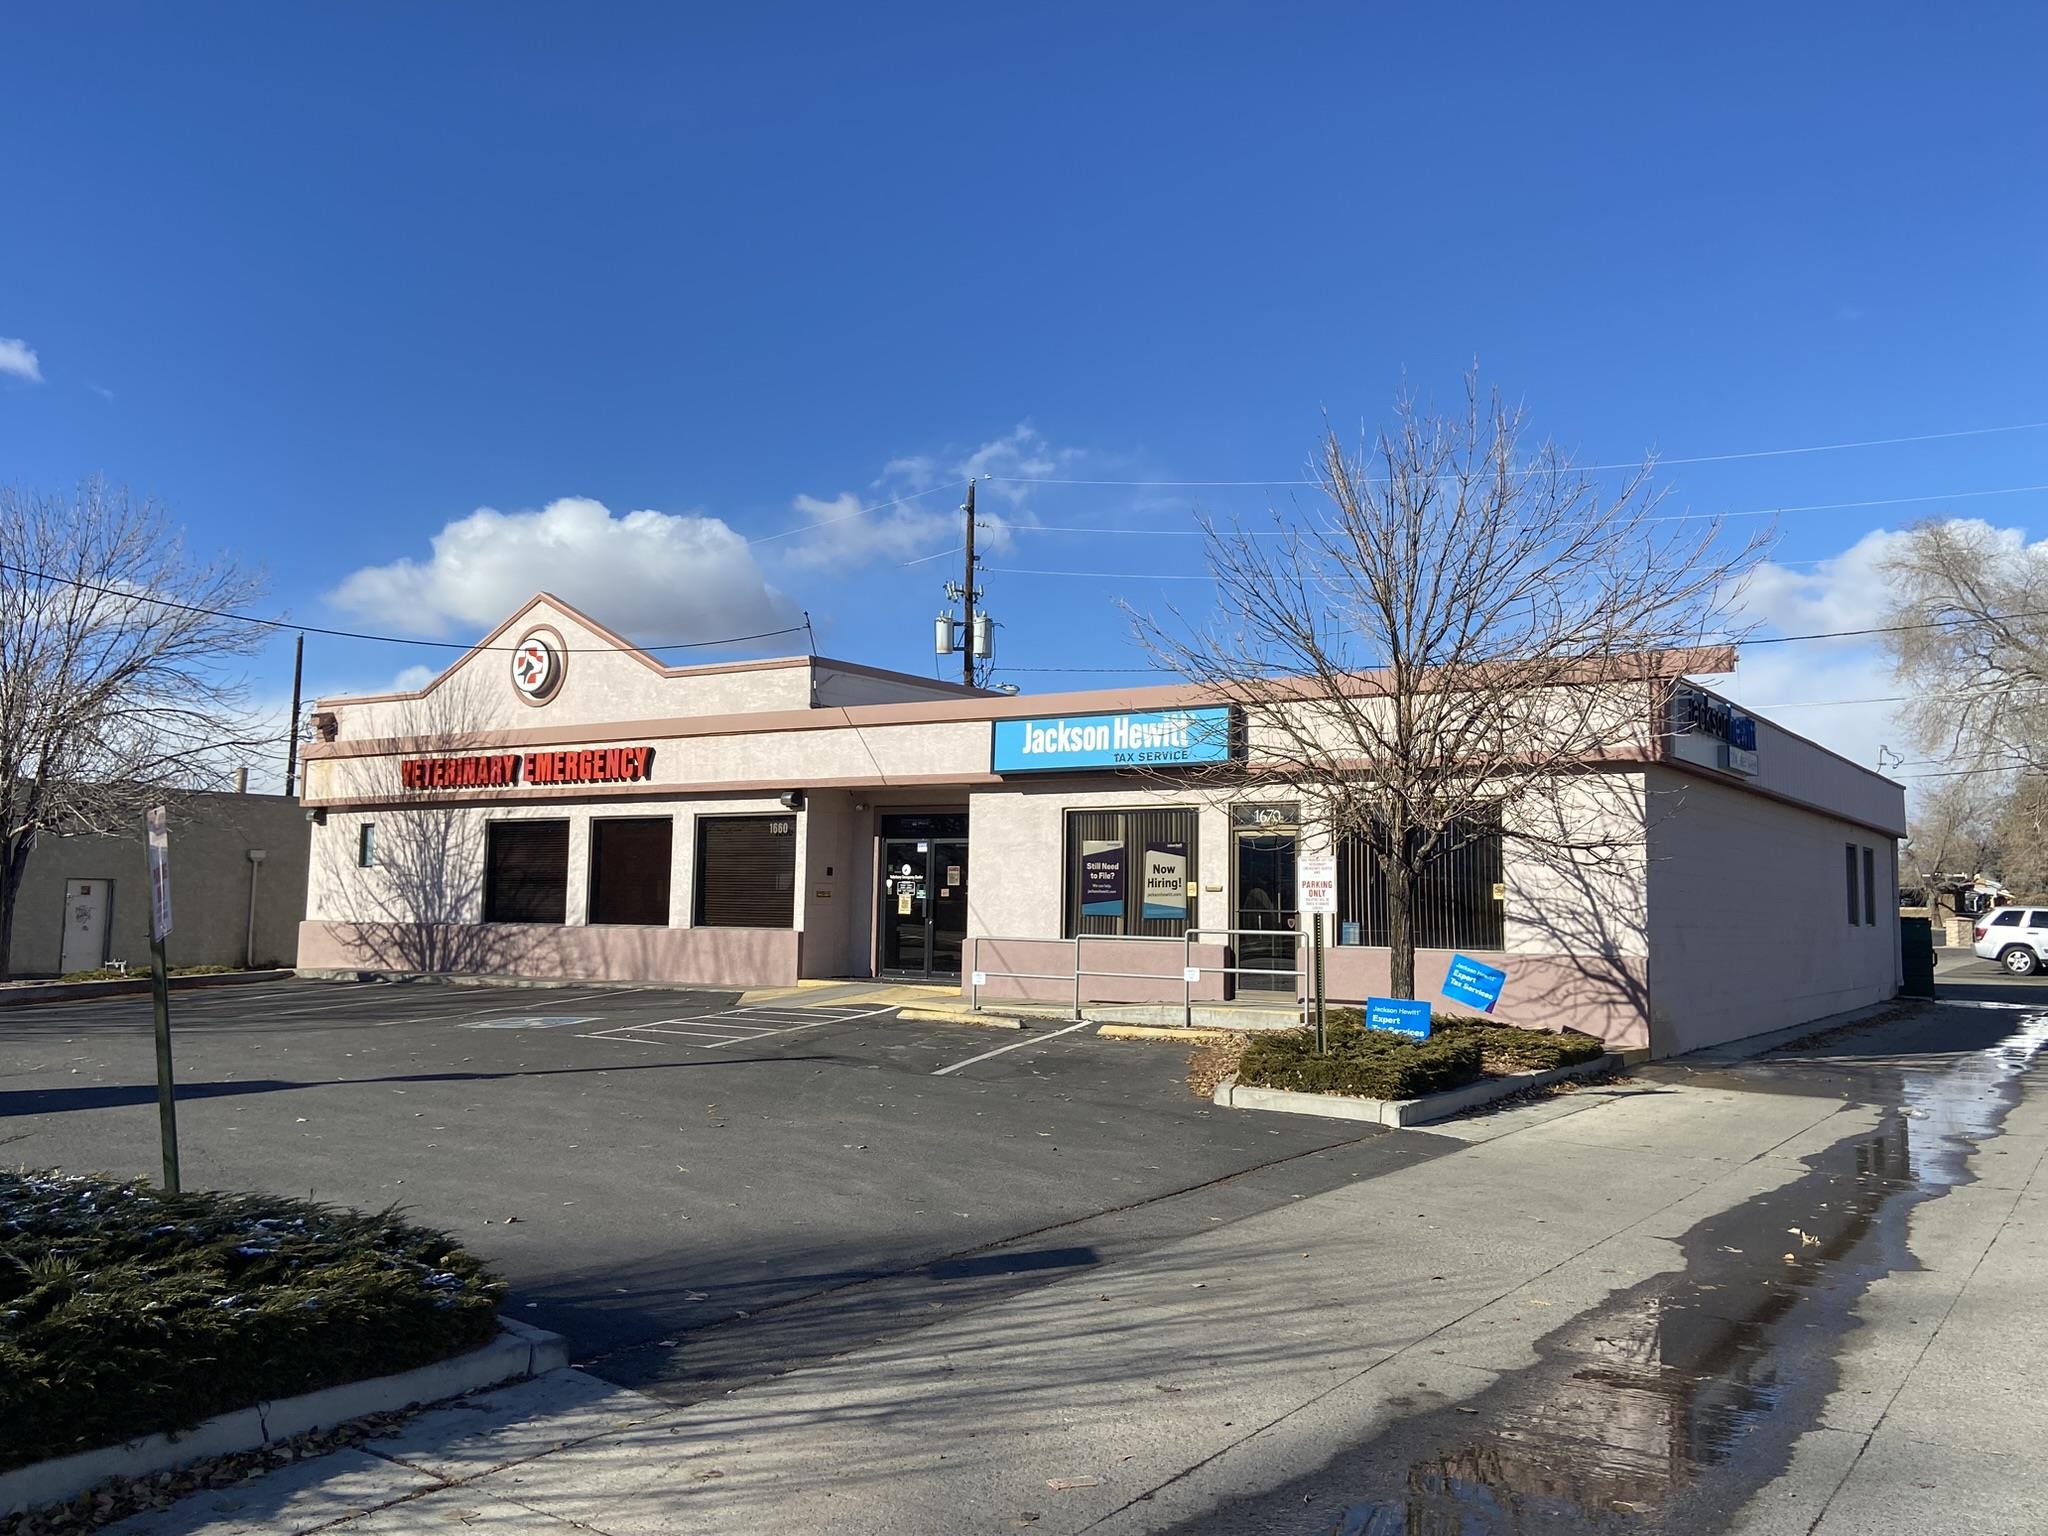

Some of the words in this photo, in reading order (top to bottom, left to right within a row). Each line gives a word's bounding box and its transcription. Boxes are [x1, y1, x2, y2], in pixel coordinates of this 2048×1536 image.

[1022, 720, 1110, 754] Jackson
[1113, 713, 1190, 750] Hewitt
[1114, 753, 1135, 763] TAX
[1138, 750, 1188, 761] SERVICE
[402, 754, 516, 787] VETERINARY
[523, 747, 650, 782] EMERGENCY
[1254, 809, 1281, 823] 1670
[770, 822, 788, 834] 1660
[1086, 862, 1101, 870] Still
[1101, 862, 1119, 870] Need
[1152, 864, 1175, 874] Now
[1090, 872, 1097, 880] to
[1098, 872, 1116, 880] File?
[1147, 877, 1182, 890] Hiring!
[1301, 880, 1333, 889] PARKING
[1308, 889, 1326, 898] ONLY
[1455, 962, 1477, 975] Jackson
[1453, 969, 1477, 984] Expert
[1450, 977, 1463, 989] Tax
[1462, 982, 1494, 1000] Services
[1372, 1005, 1398, 1014] Jackson
[1398, 1008, 1420, 1016] Hewitt
[1372, 1014, 1400, 1025] Expert
